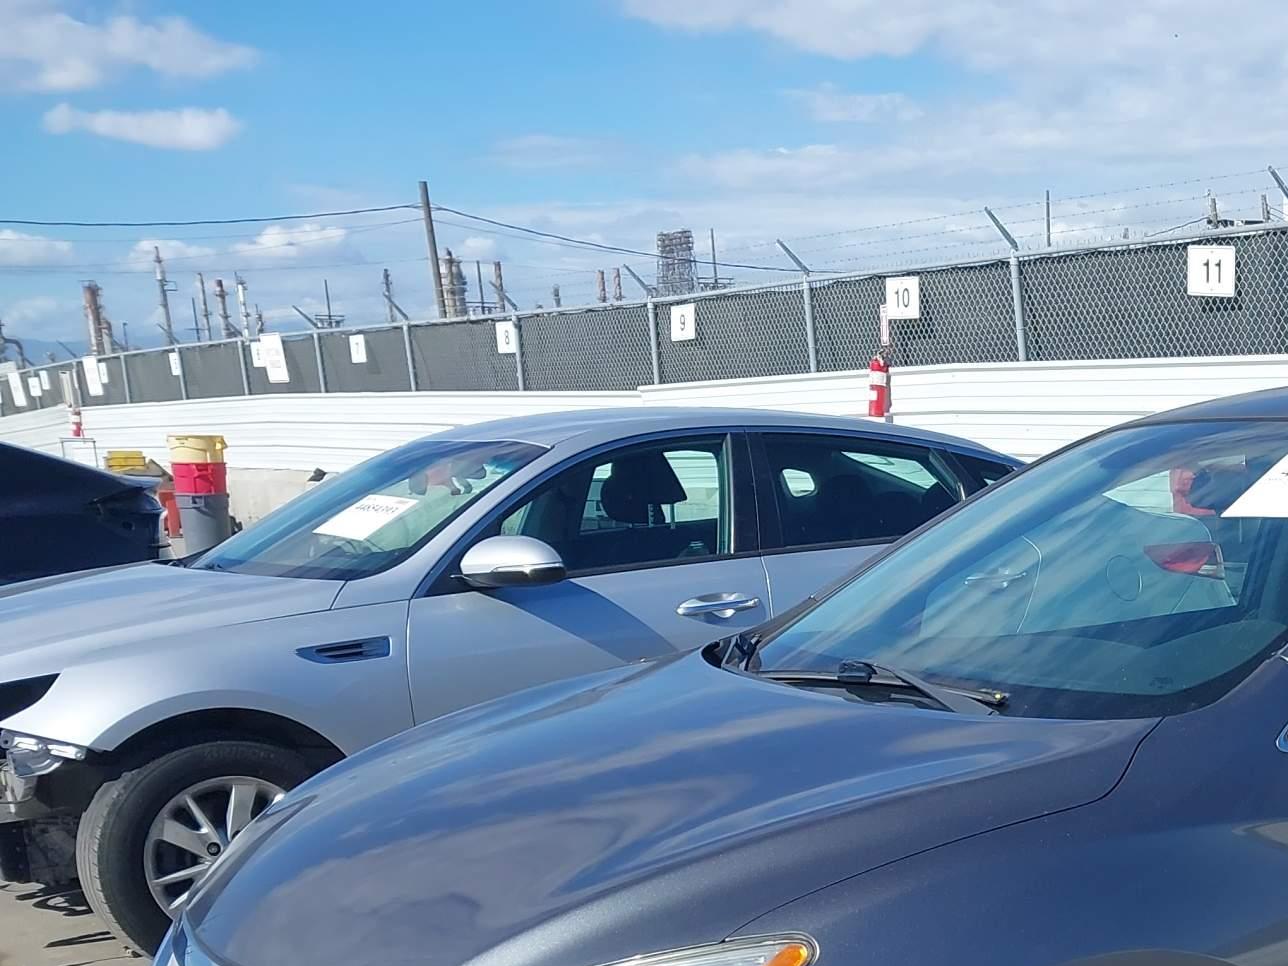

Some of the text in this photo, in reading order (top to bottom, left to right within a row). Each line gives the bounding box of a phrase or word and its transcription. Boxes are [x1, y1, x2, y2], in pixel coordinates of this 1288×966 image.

[1202, 258, 1223, 285] 11
[893, 286, 910, 310] 10
[679, 313, 686, 331] 9
[503, 329, 510, 345] 8
